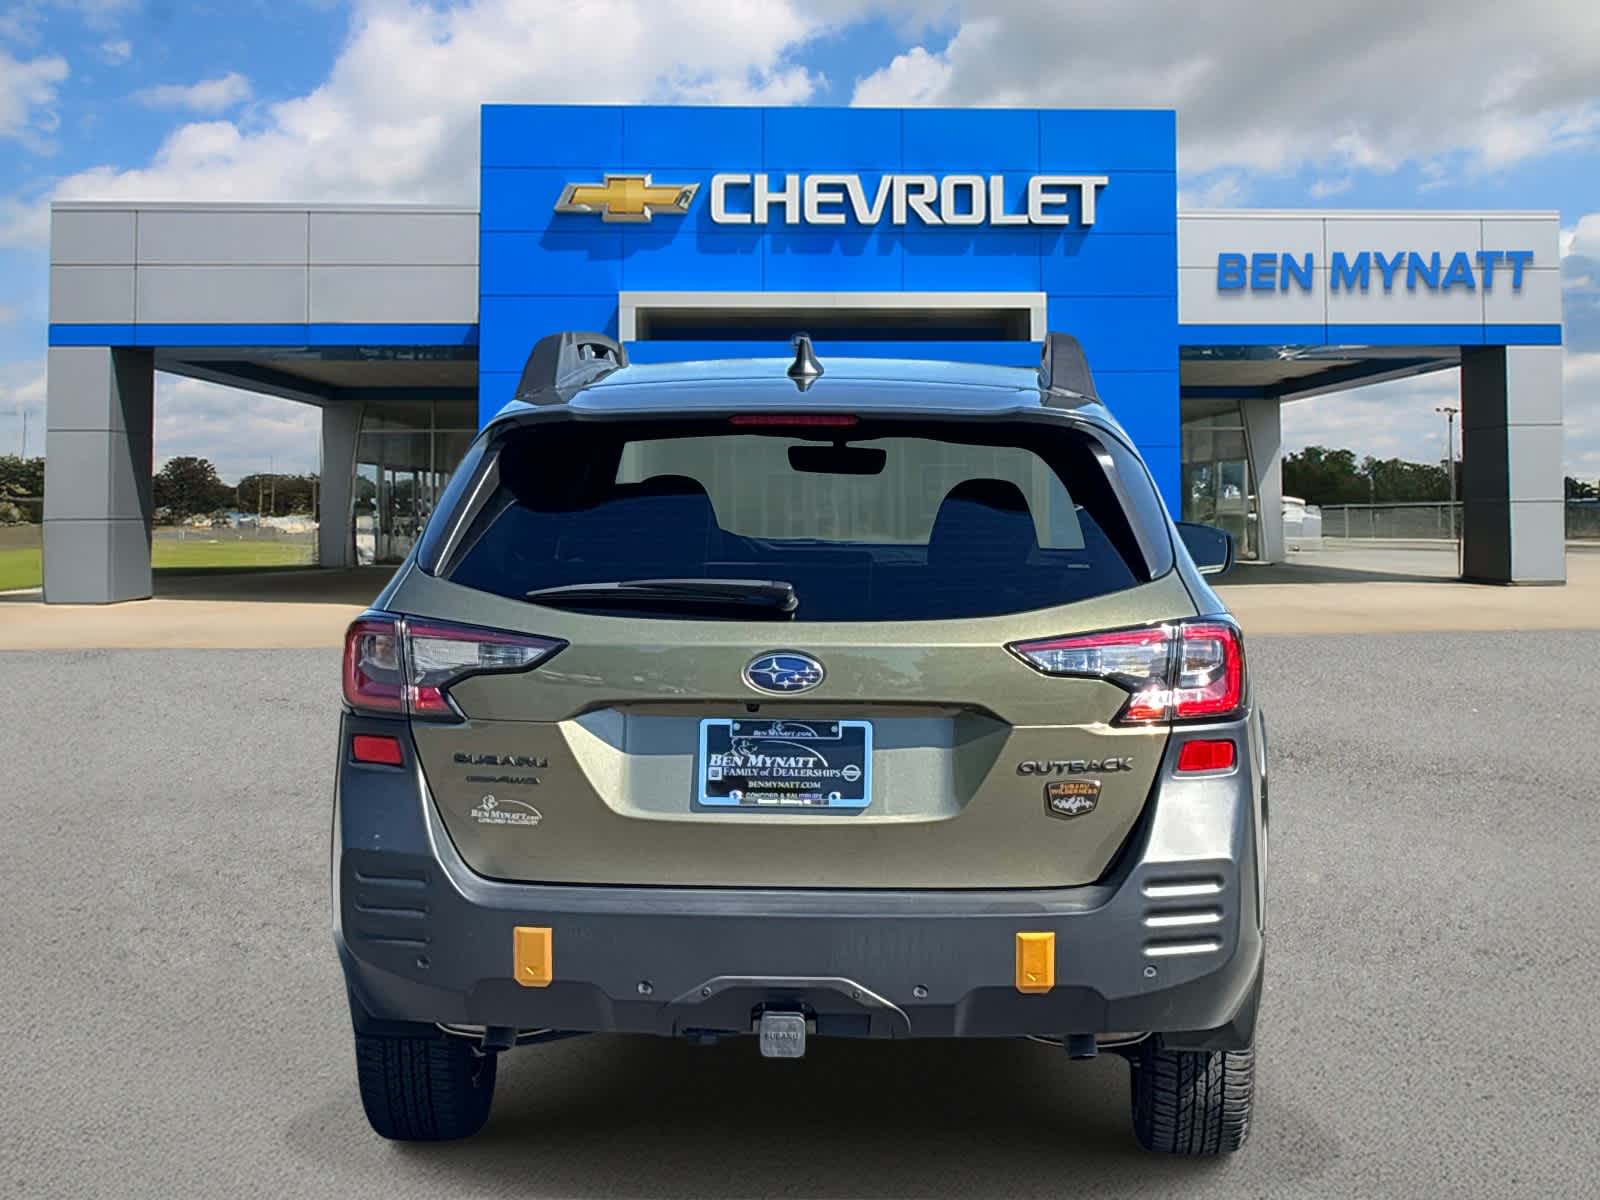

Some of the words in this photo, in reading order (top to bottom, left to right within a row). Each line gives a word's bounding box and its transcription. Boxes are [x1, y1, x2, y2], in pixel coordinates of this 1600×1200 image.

[710, 173, 1109, 227] CHEVROLET
[1217, 252, 1313, 290] BEN
[1330, 251, 1534, 290] MYNATT
[454, 753, 548, 768] SUBARU
[709, 753, 744, 767] BEN
[747, 754, 818, 768] MYNATT
[1016, 757, 1134, 776] OUTBACK
[722, 768, 759, 777] FAMILY
[773, 768, 841, 778] DEALERSHIPS
